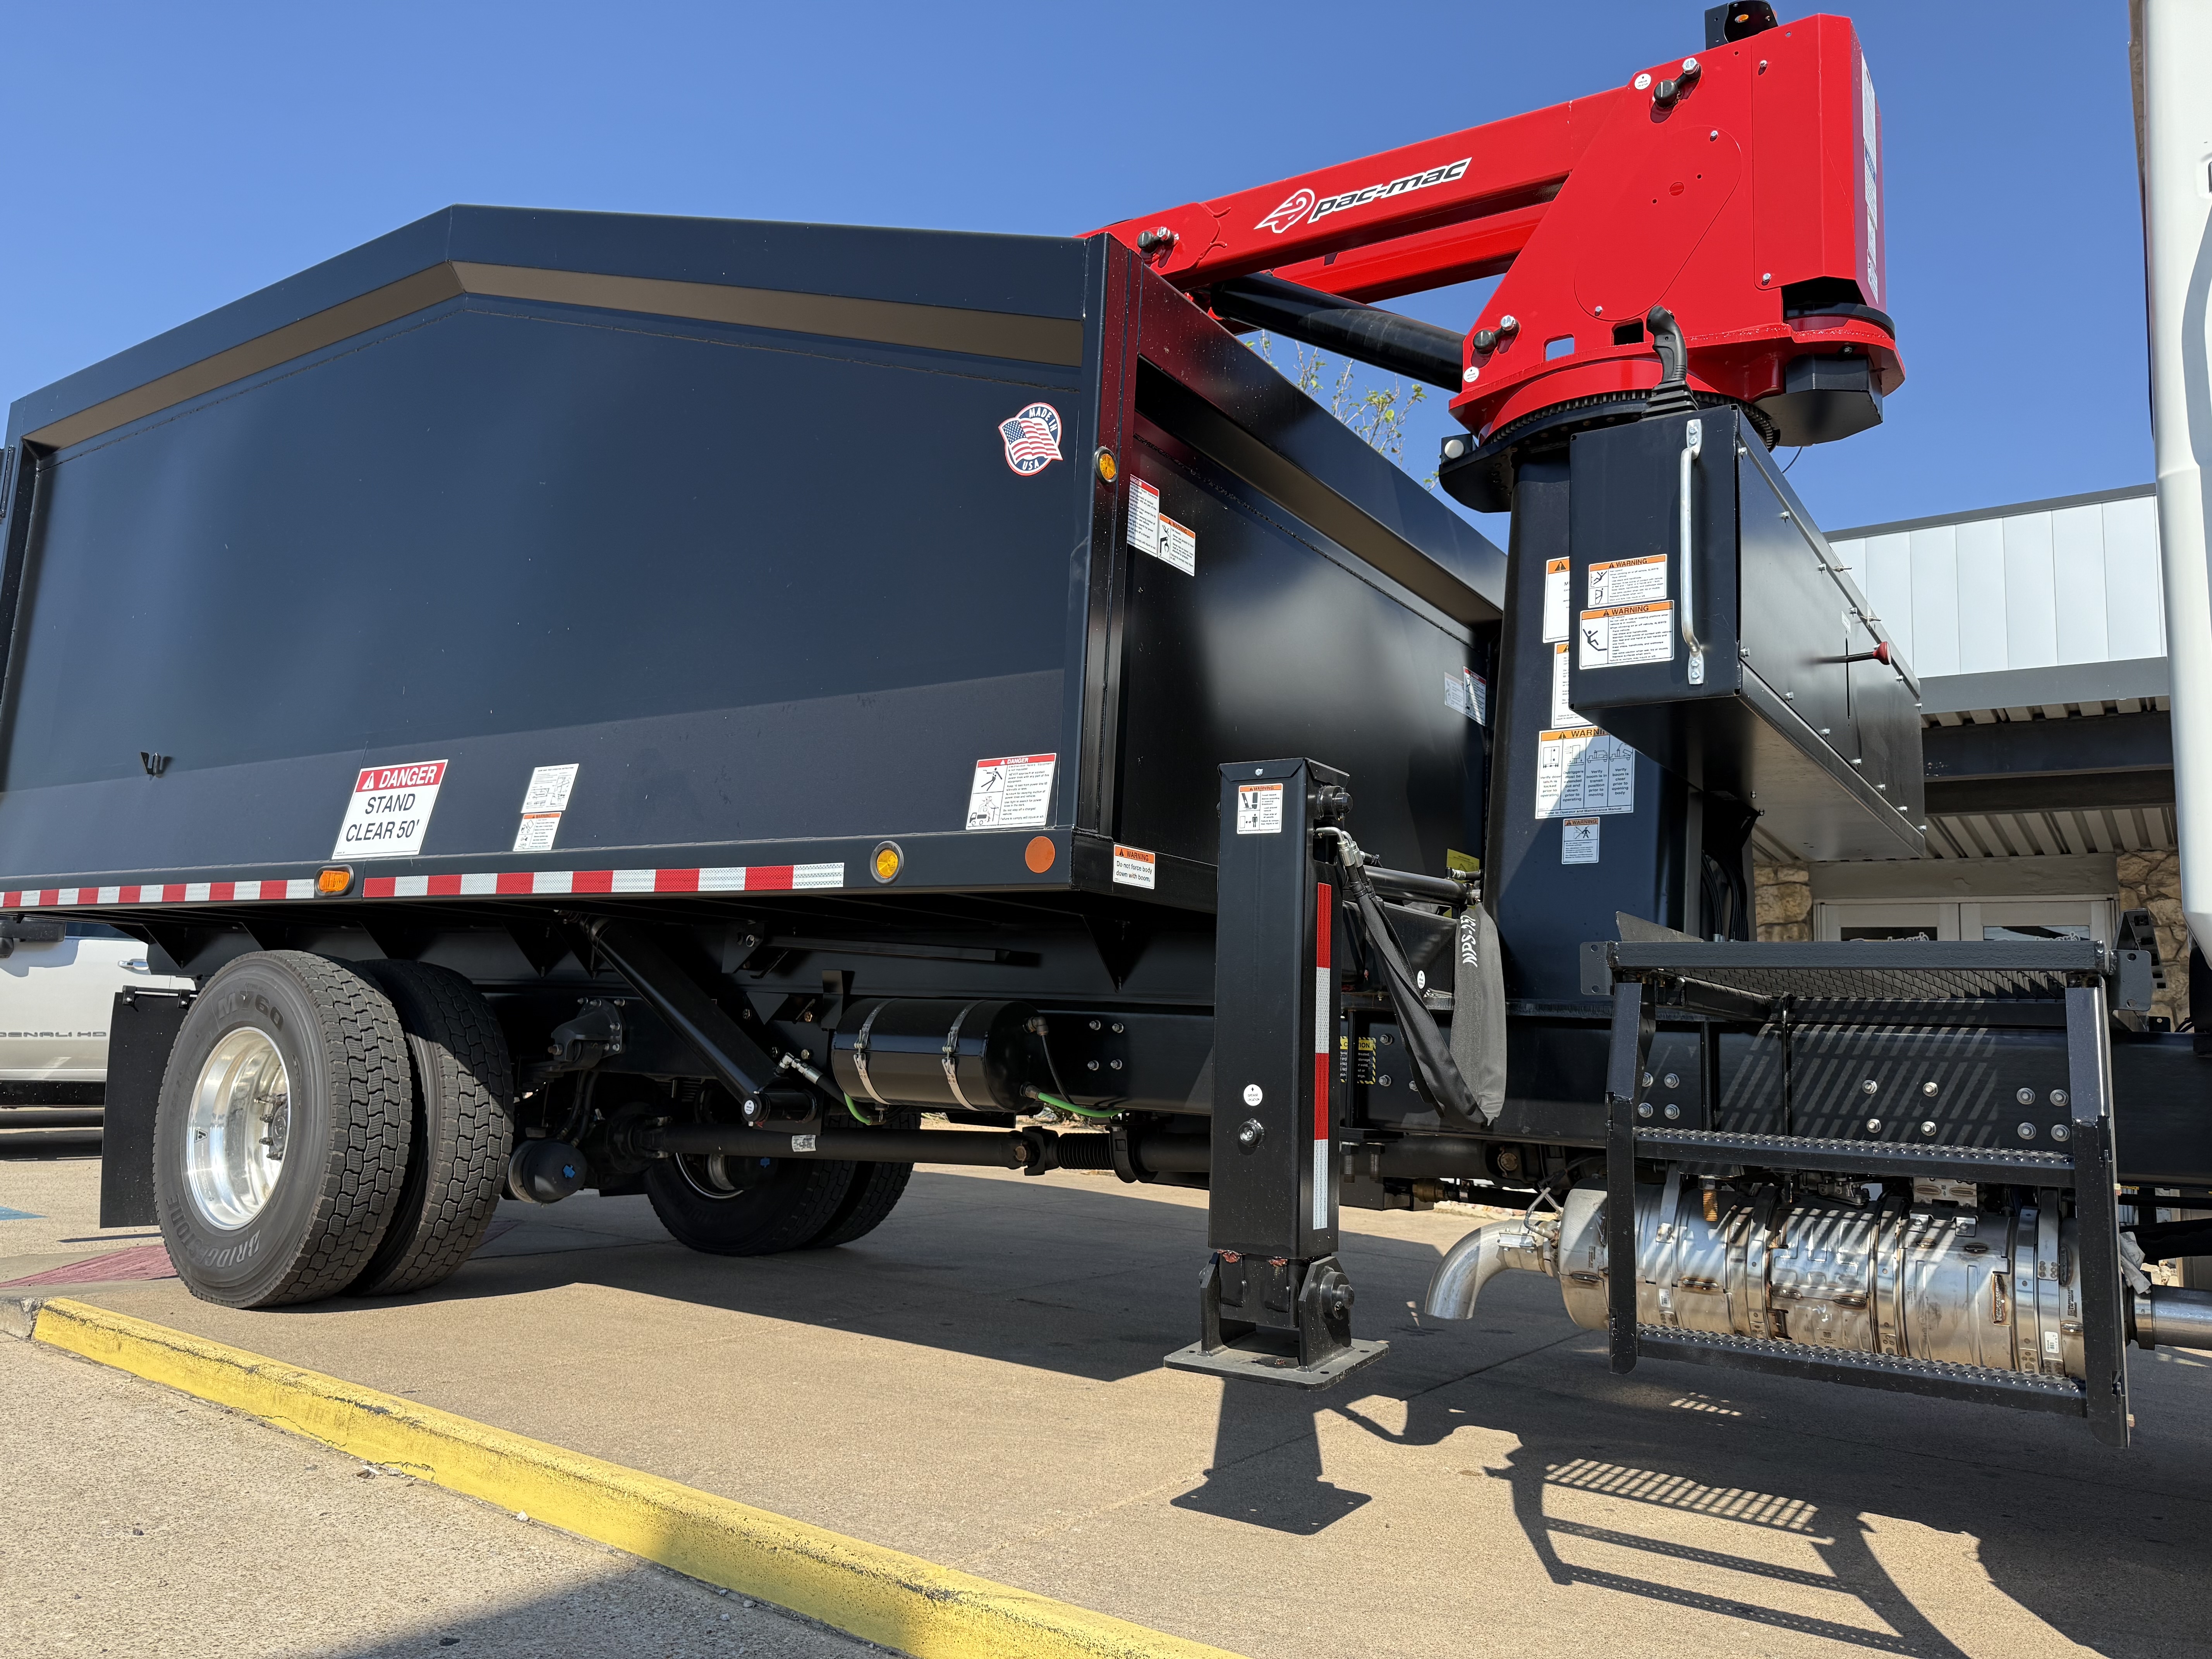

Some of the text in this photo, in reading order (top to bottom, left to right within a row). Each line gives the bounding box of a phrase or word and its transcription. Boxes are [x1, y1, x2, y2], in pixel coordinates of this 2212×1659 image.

[1309, 159, 1471, 222] pac-mac
[1029, 407, 1058, 432] MADE IN
[1022, 459, 1039, 471] USA
[1616, 559, 1647, 567] WARNING
[1612, 606, 1649, 615] WARNING
[378, 765, 437, 788] DANGER
[365, 793, 416, 814] STAND
[346, 819, 420, 842] CLEAR 50'
[1127, 850, 1149, 861] WARNING
[1142, 866, 1152, 874] body
[218, 991, 285, 1032] M760
[166, 1193, 261, 1268] BRIDGESTONE
